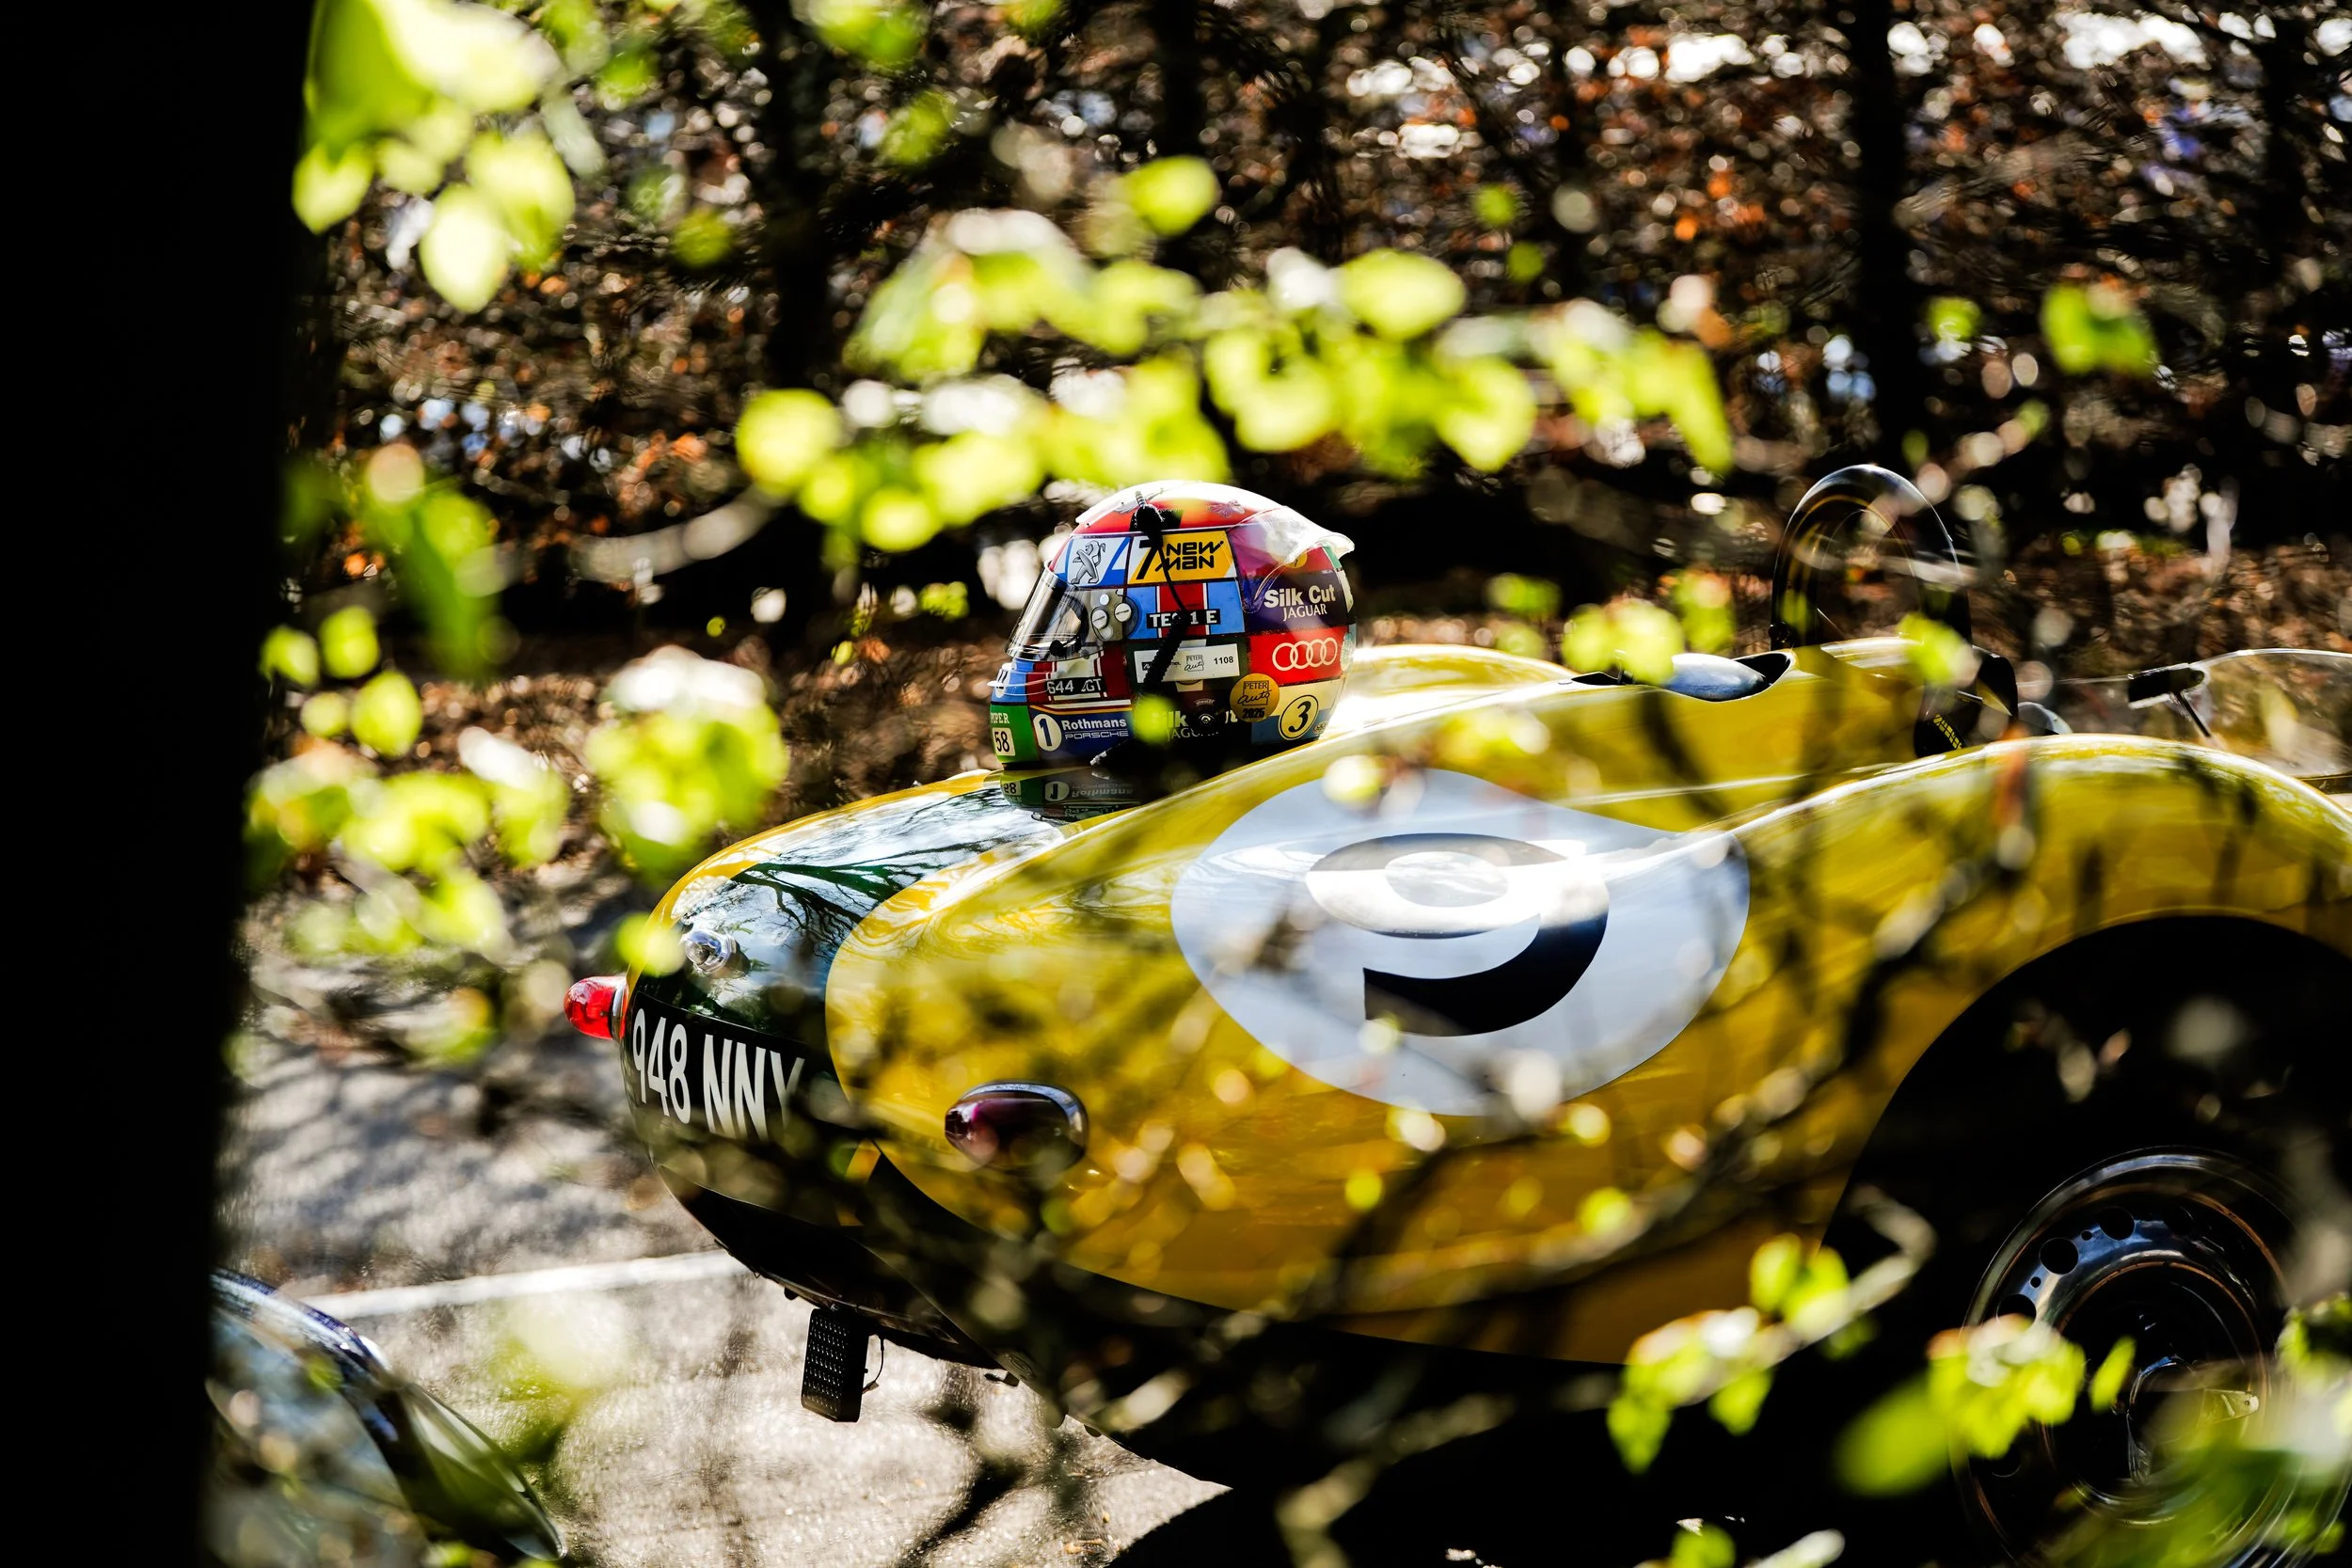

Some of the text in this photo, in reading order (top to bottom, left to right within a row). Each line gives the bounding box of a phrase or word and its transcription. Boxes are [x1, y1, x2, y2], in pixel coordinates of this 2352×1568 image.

[1263, 584, 1336, 609] Silk Cut
[1282, 604, 1327, 622] JAGUAR
[1214, 656, 1234, 665] 1108
[1046, 680, 1074, 694] 644
[1244, 682, 1268, 690] PETER
[1237, 690, 1271, 705] auto
[1061, 718, 1127, 731] Rothmans
[1287, 700, 1311, 733] 3
[993, 731, 1010, 752] 58
[1039, 718, 1053, 747] 1
[1064, 731, 1129, 740] PORSCHE
[1306, 832, 1610, 1037] 9
[632, 1007, 806, 1141] 948 NNY
